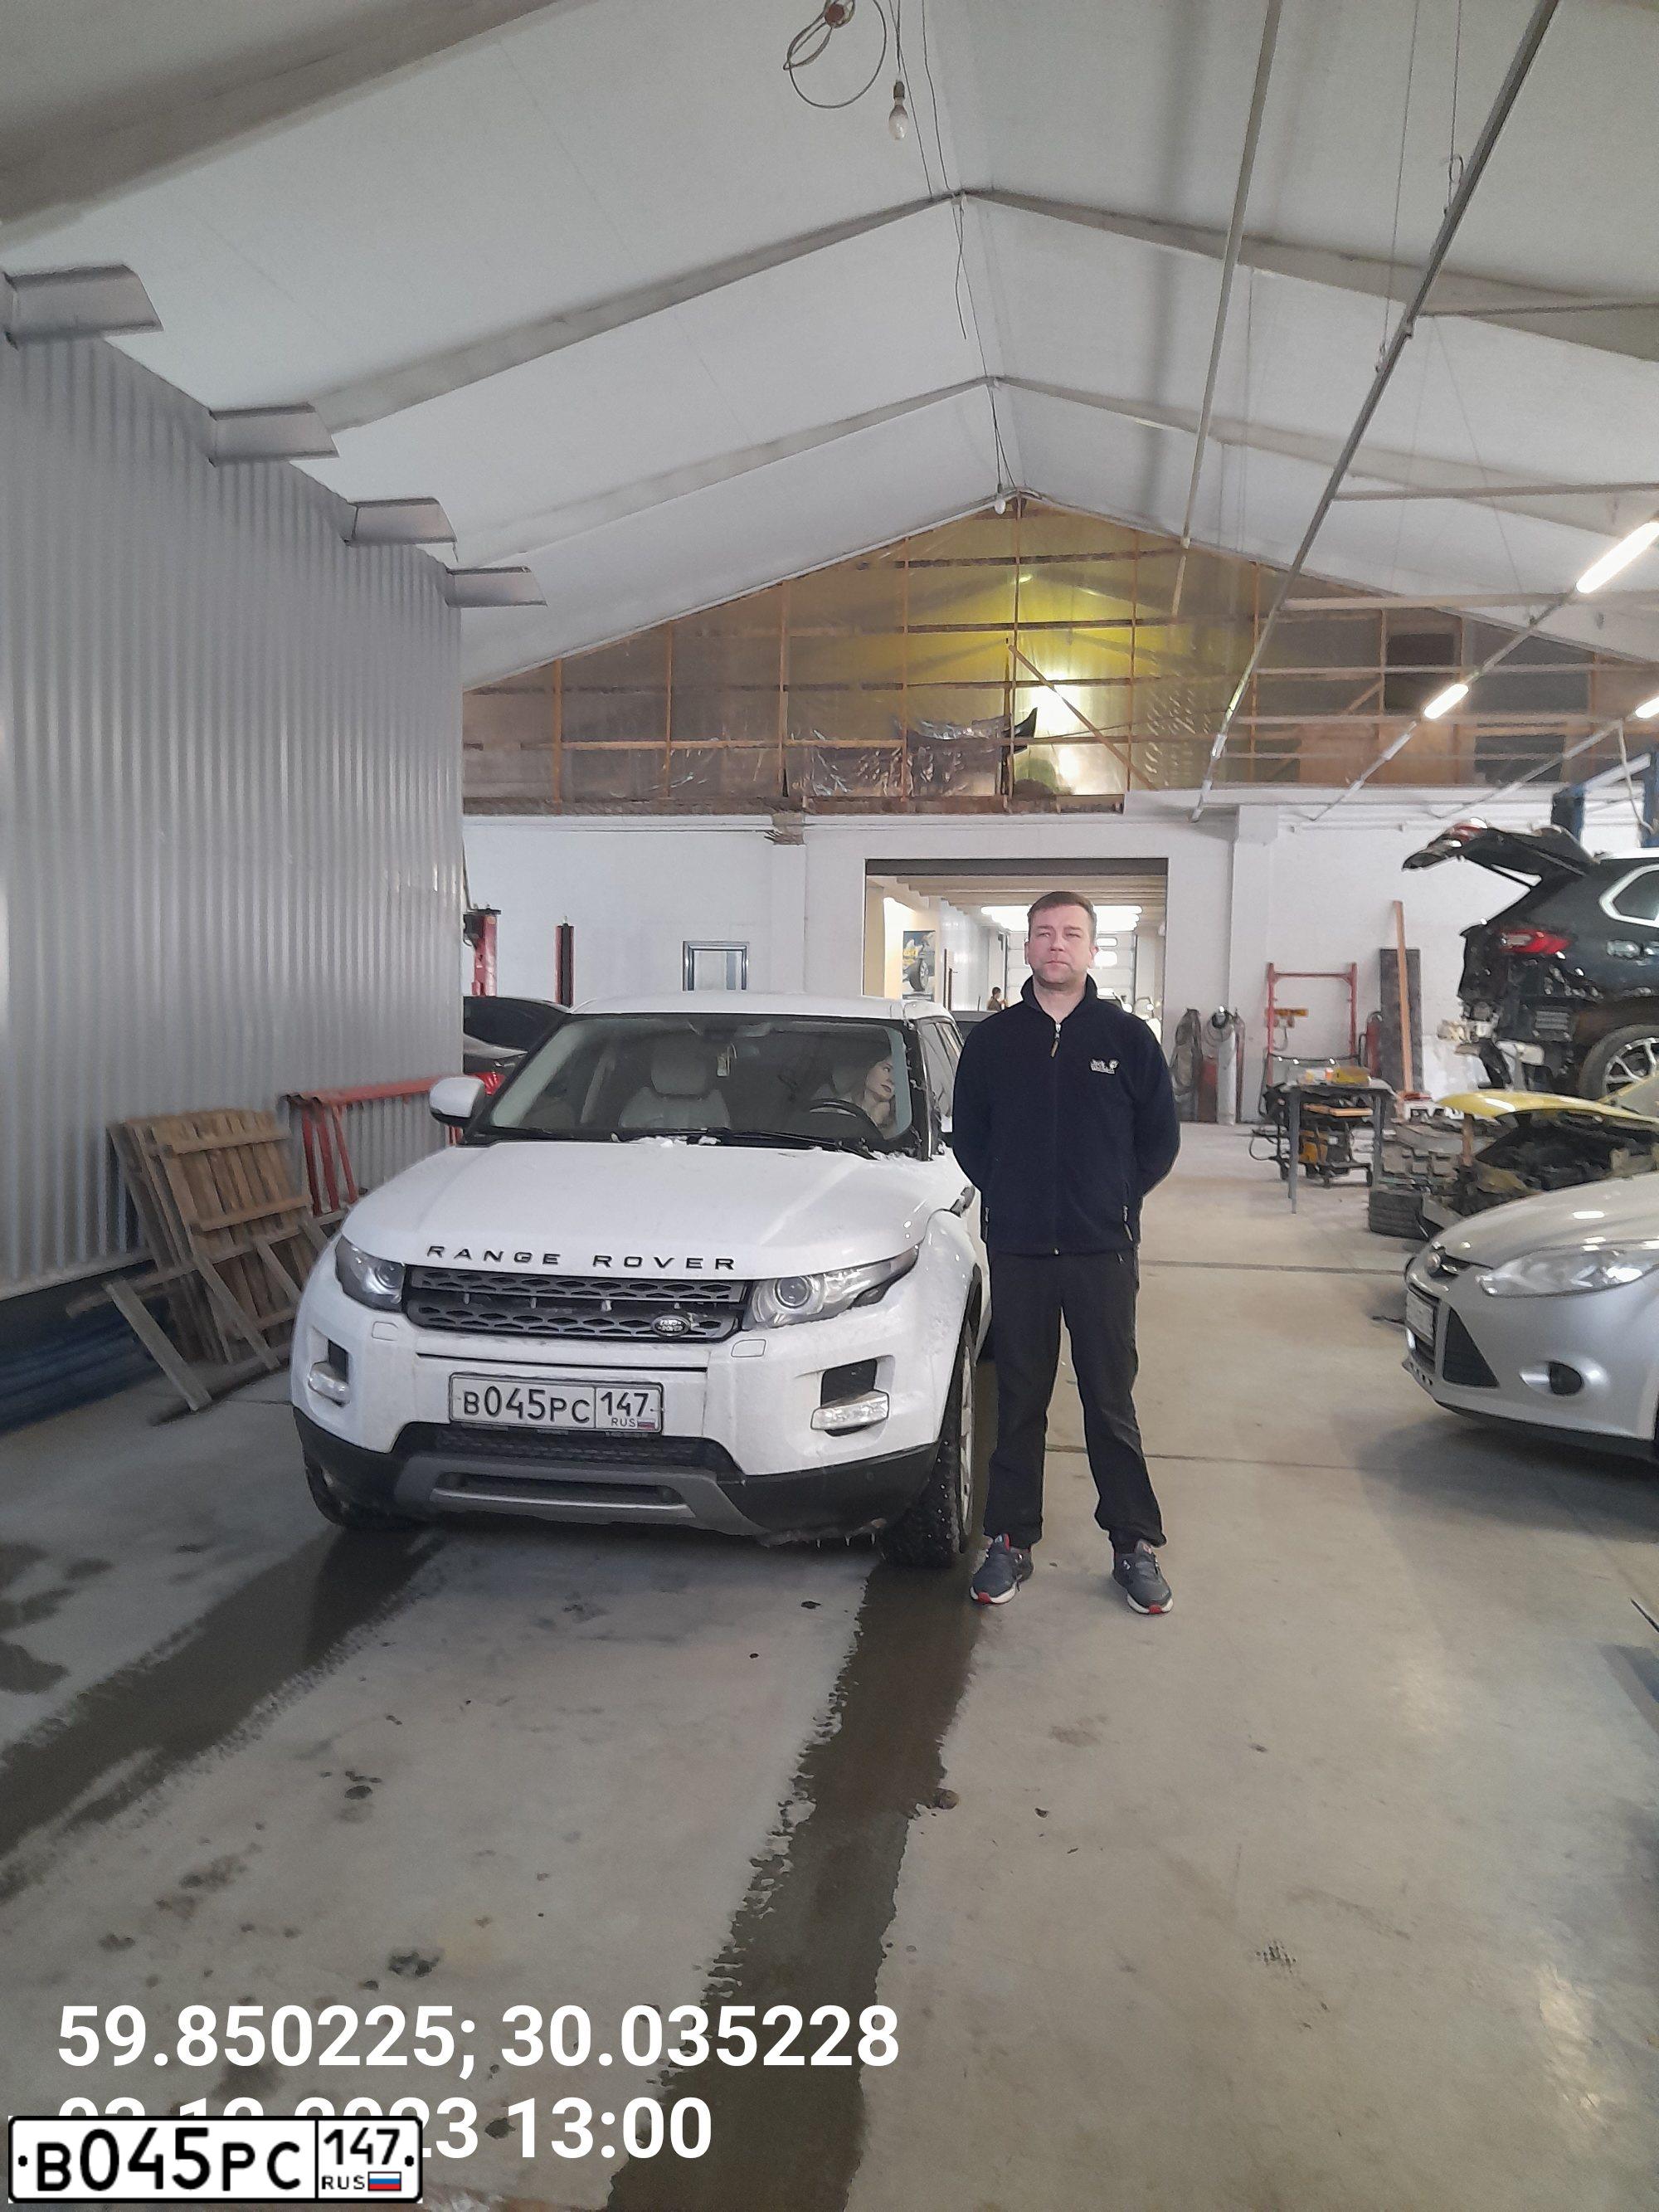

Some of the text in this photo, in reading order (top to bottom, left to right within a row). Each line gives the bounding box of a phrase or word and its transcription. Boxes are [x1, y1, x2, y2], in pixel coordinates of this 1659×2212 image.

[426, 1245, 736, 1271] RANGE ROVER
[600, 1391, 649, 1417] 147
[611, 1416, 637, 1428] RUS
